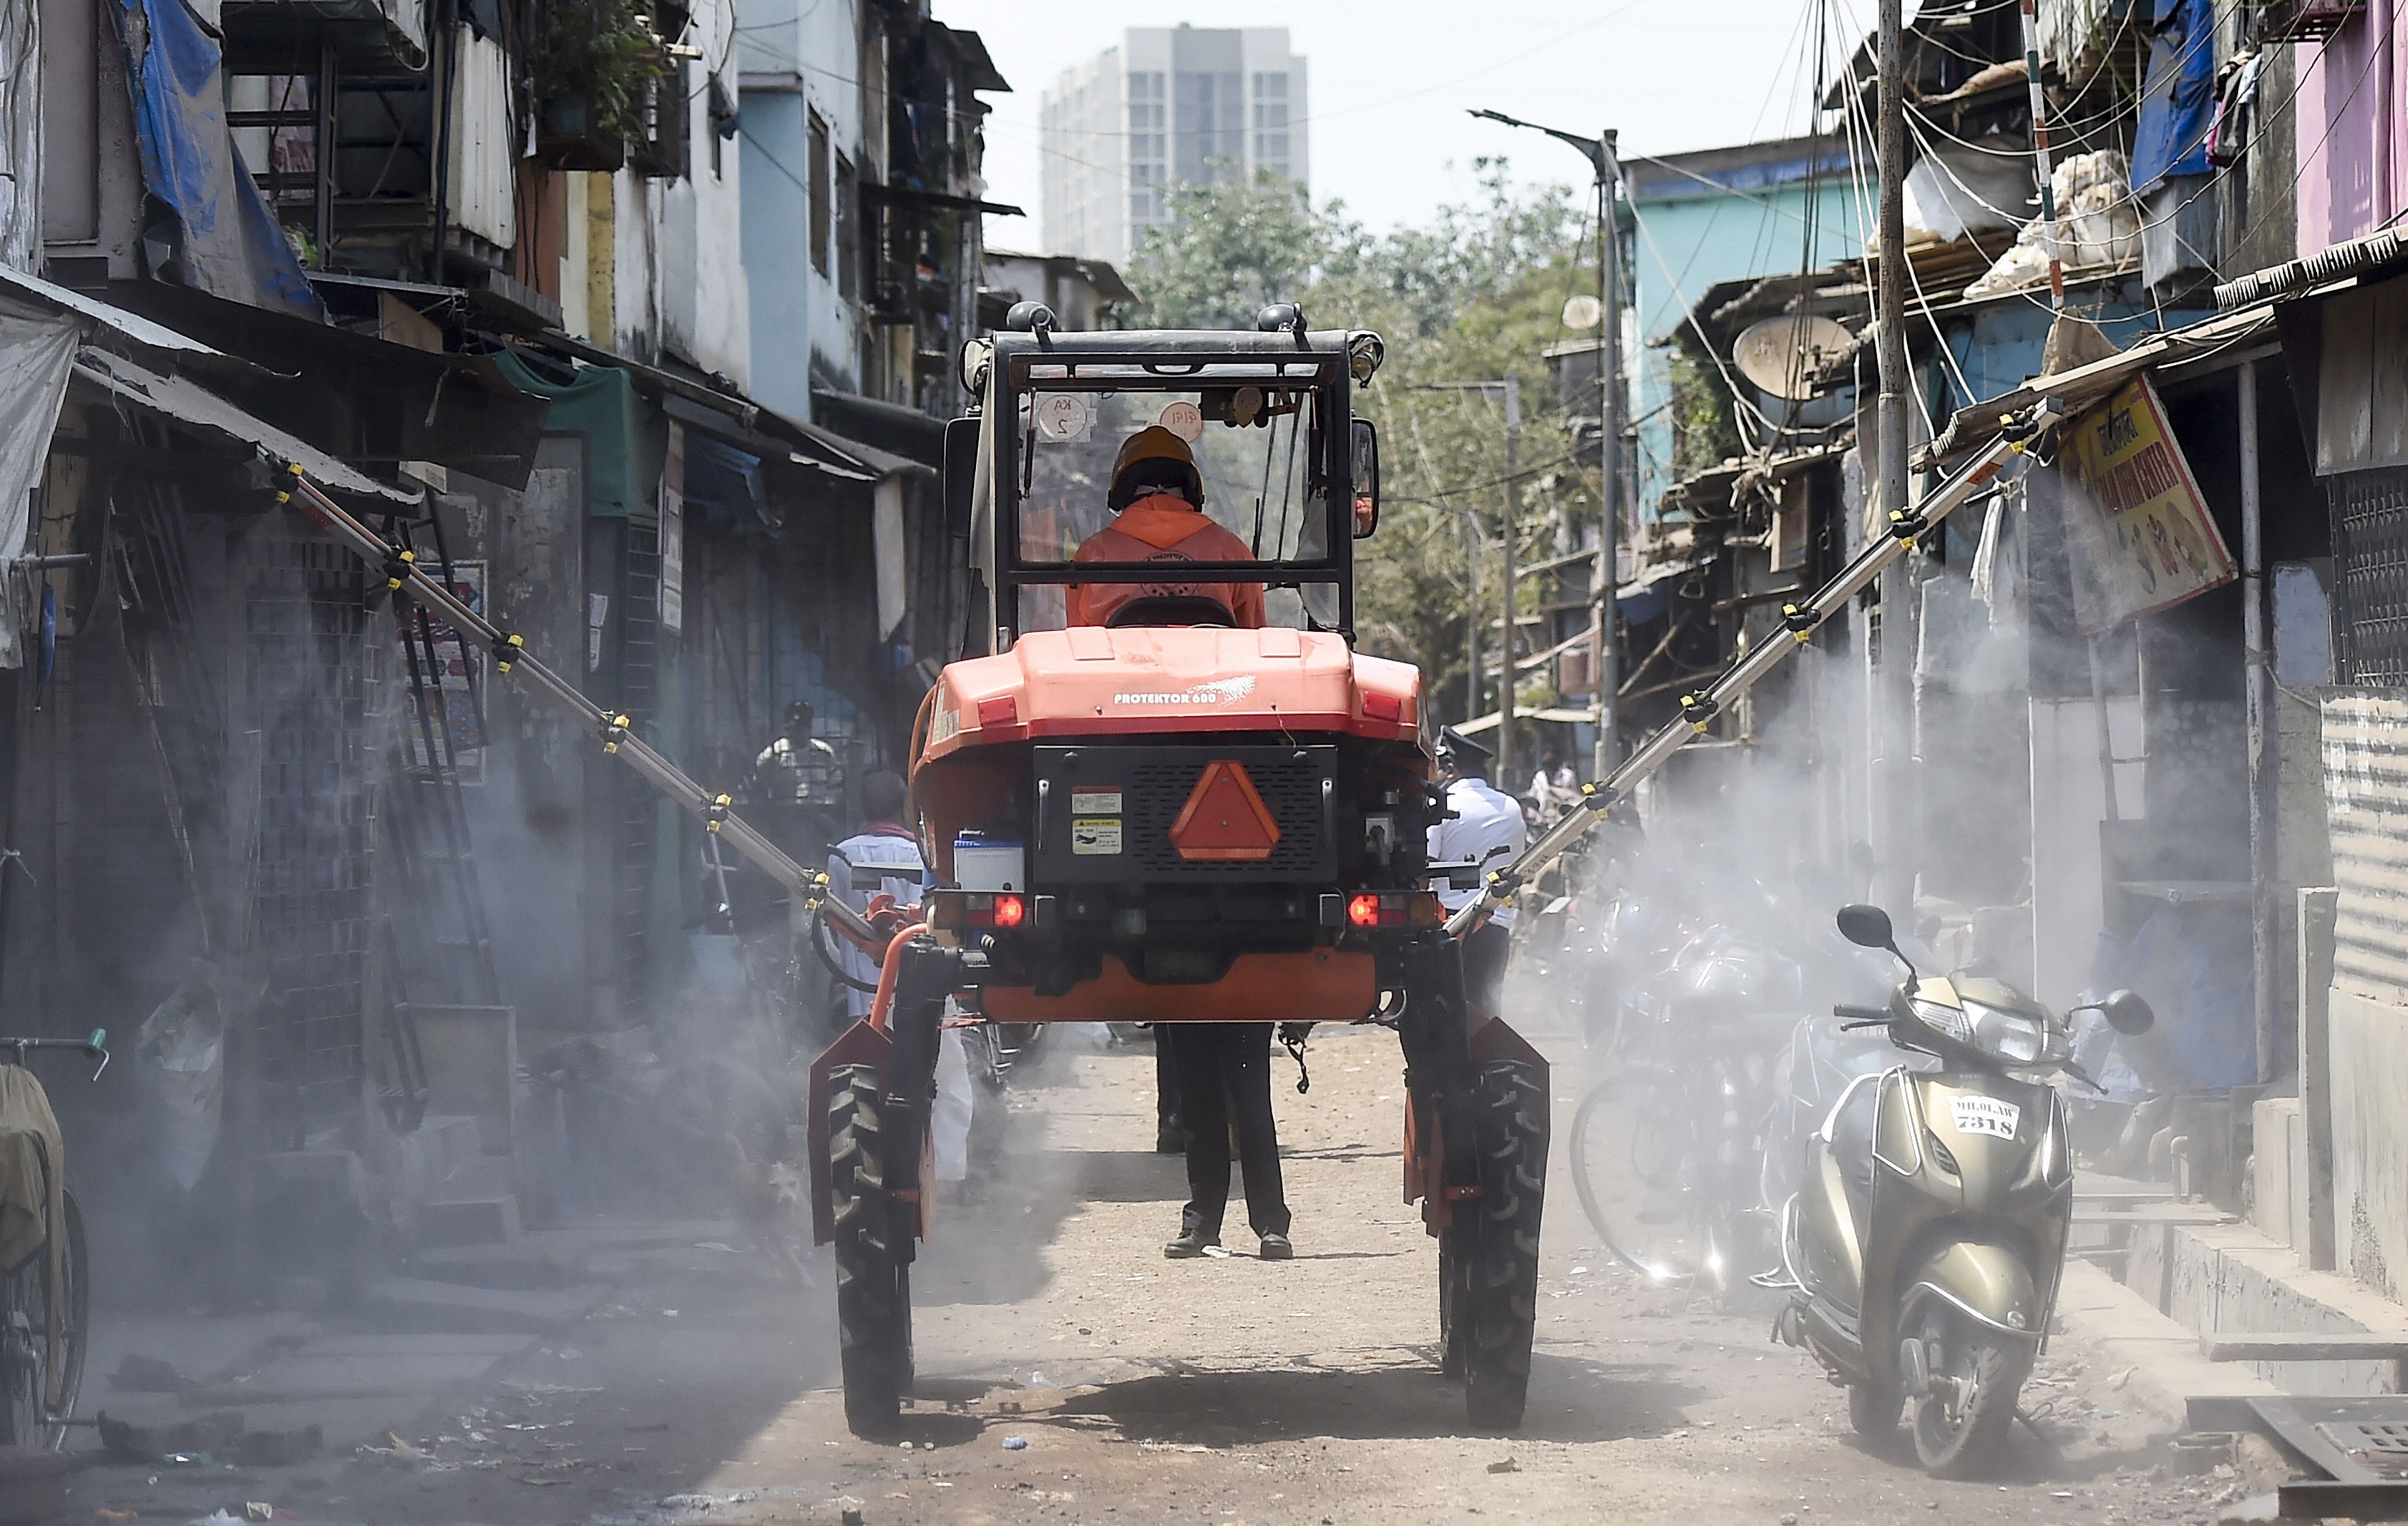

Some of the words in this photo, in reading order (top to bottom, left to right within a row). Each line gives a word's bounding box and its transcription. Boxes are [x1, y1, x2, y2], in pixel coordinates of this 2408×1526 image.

[1114, 693, 1189, 704] PROTEKTOR
[1192, 693, 1216, 704] 600
[1958, 1117, 2013, 1135] 7318
